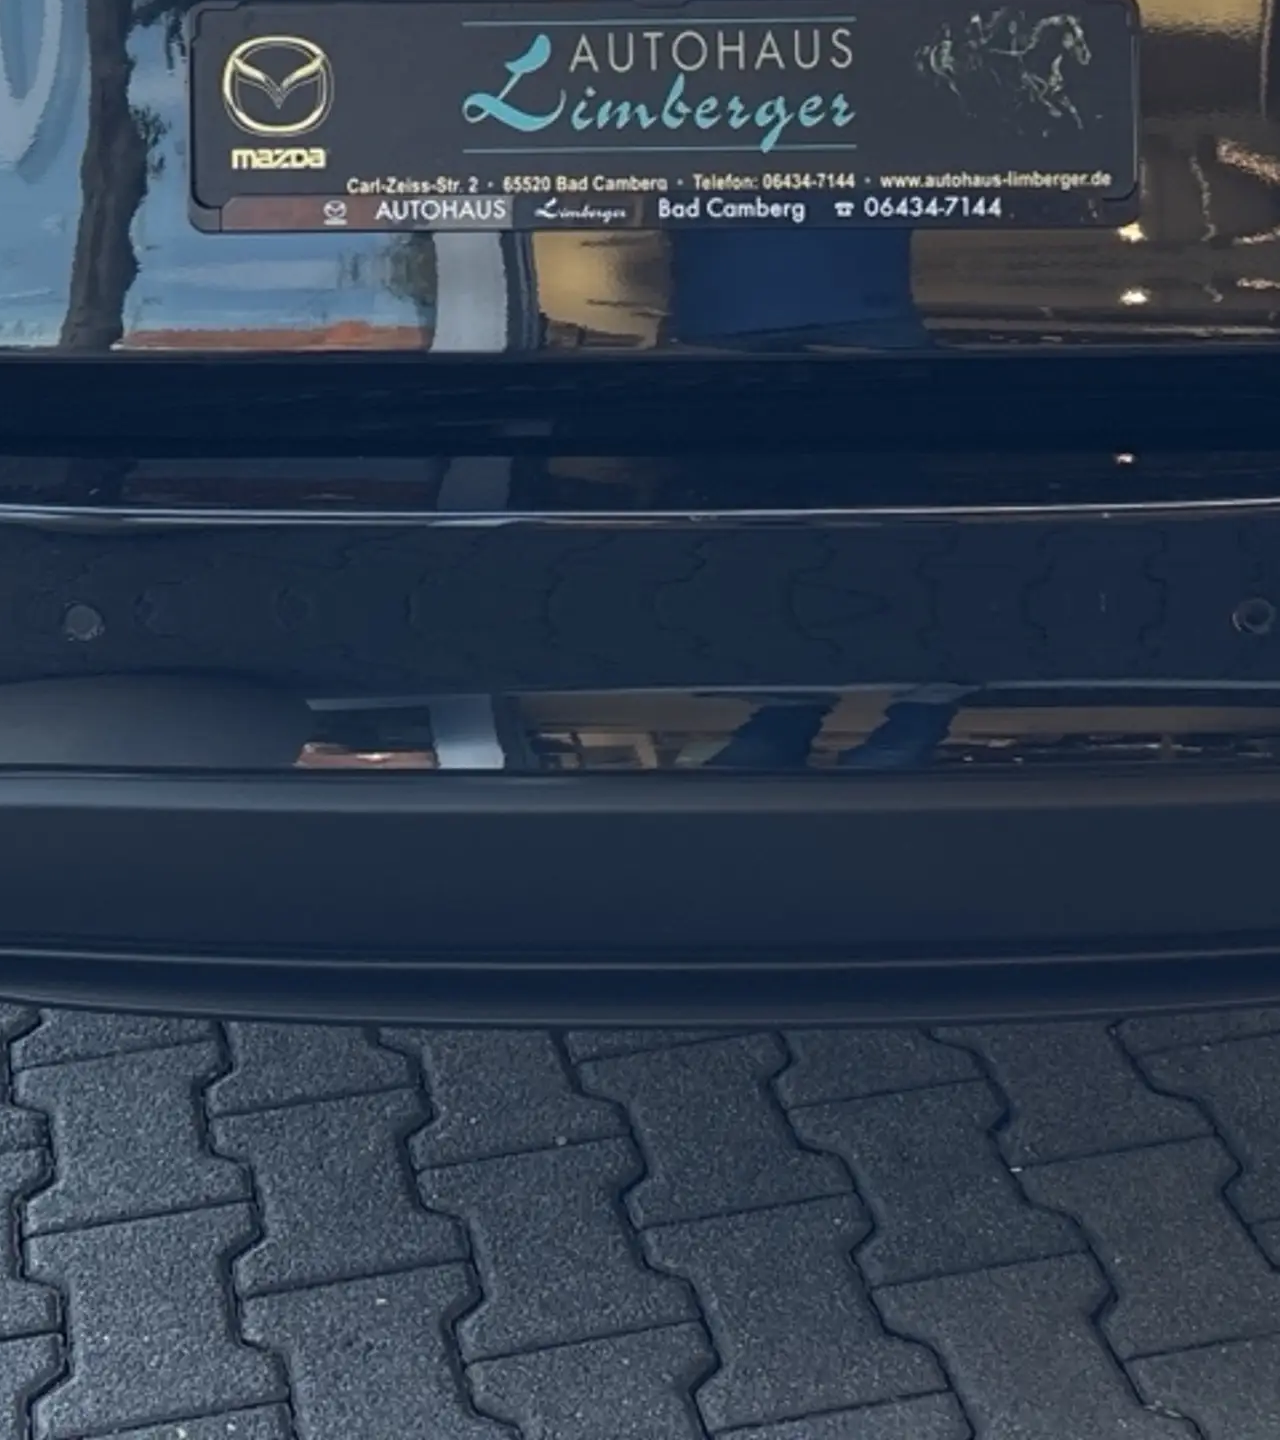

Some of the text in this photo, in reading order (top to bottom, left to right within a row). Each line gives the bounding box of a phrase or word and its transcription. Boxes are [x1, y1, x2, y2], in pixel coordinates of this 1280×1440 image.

[569, 27, 854, 73] AUTOHAUS
[462, 33, 857, 153] Limberger
[346, 170, 1112, 194] Carl-Zeiss-Str. 2 65520 Bad Camberg Telefon: 06434-7144 www.autohaus-limberger.de
[374, 198, 507, 221] AUTOHAUS
[658, 196, 700, 219] Bad
[706, 195, 805, 223] Camberg
[863, 195, 1003, 219] 06434-7144
